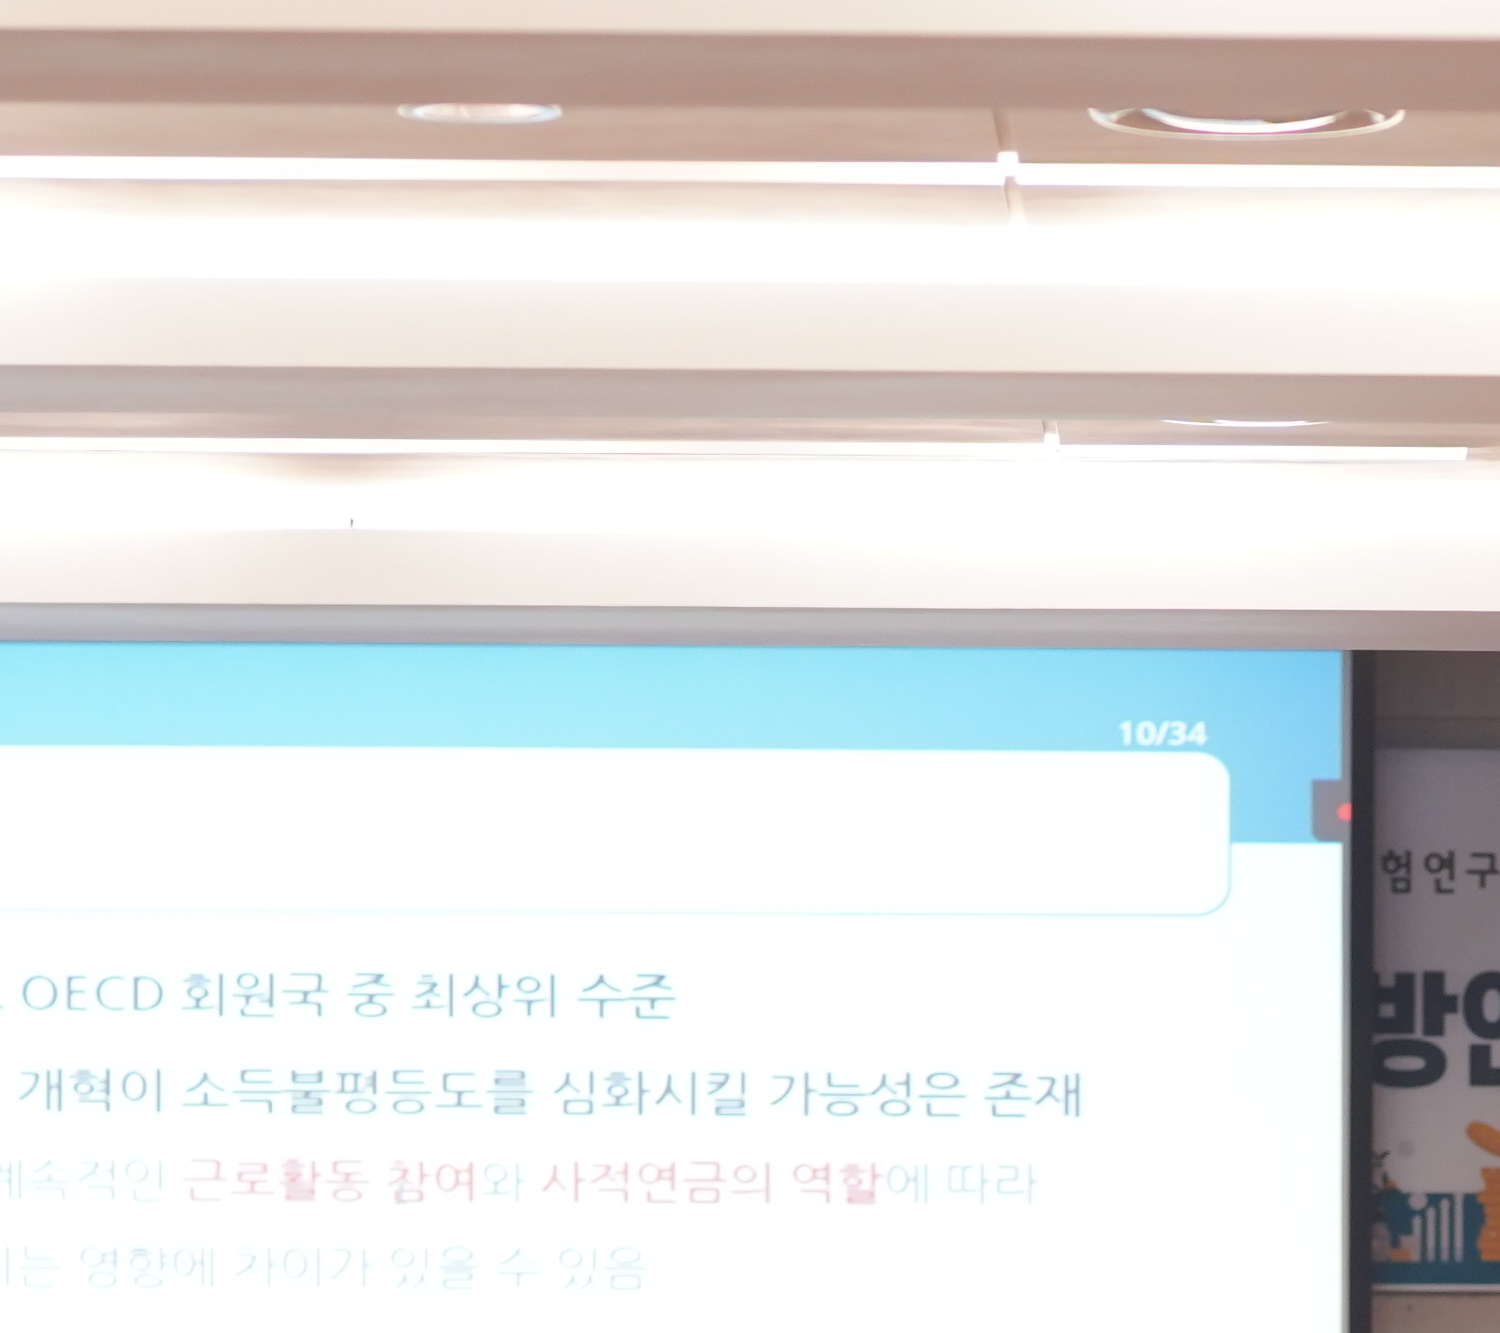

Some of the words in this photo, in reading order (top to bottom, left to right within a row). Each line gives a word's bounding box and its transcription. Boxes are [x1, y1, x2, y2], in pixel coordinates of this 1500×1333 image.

[1118, 719, 1208, 747] 10/34
[20, 974, 165, 1013] OECD
[181, 971, 329, 1019] 회원국
[347, 971, 395, 1019] 중
[412, 972, 557, 1020] 최상위
[577, 972, 677, 1021] 수준
[18, 1067, 163, 1114] 개혁이
[182, 1067, 534, 1117] 소득불평등도를
[553, 1070, 747, 1118] 심화시킬
[770, 1070, 968, 1119] 가능성은
[983, 1071, 1082, 1119] 존재
[185, 1157, 369, 1203] 근로활동
[387, 1160, 525, 1206] 참여와
[541, 1160, 772, 1205] 사적연금의
[791, 1162, 930, 1206] 역할에
[946, 1162, 1040, 1206] 따라
[79, 1245, 215, 1290] 영향에
[235, 1246, 373, 1288] 차이가
[389, 1245, 480, 1292] 있을
[497, 1247, 540, 1288] 수
[557, 1245, 648, 1292] 있음
